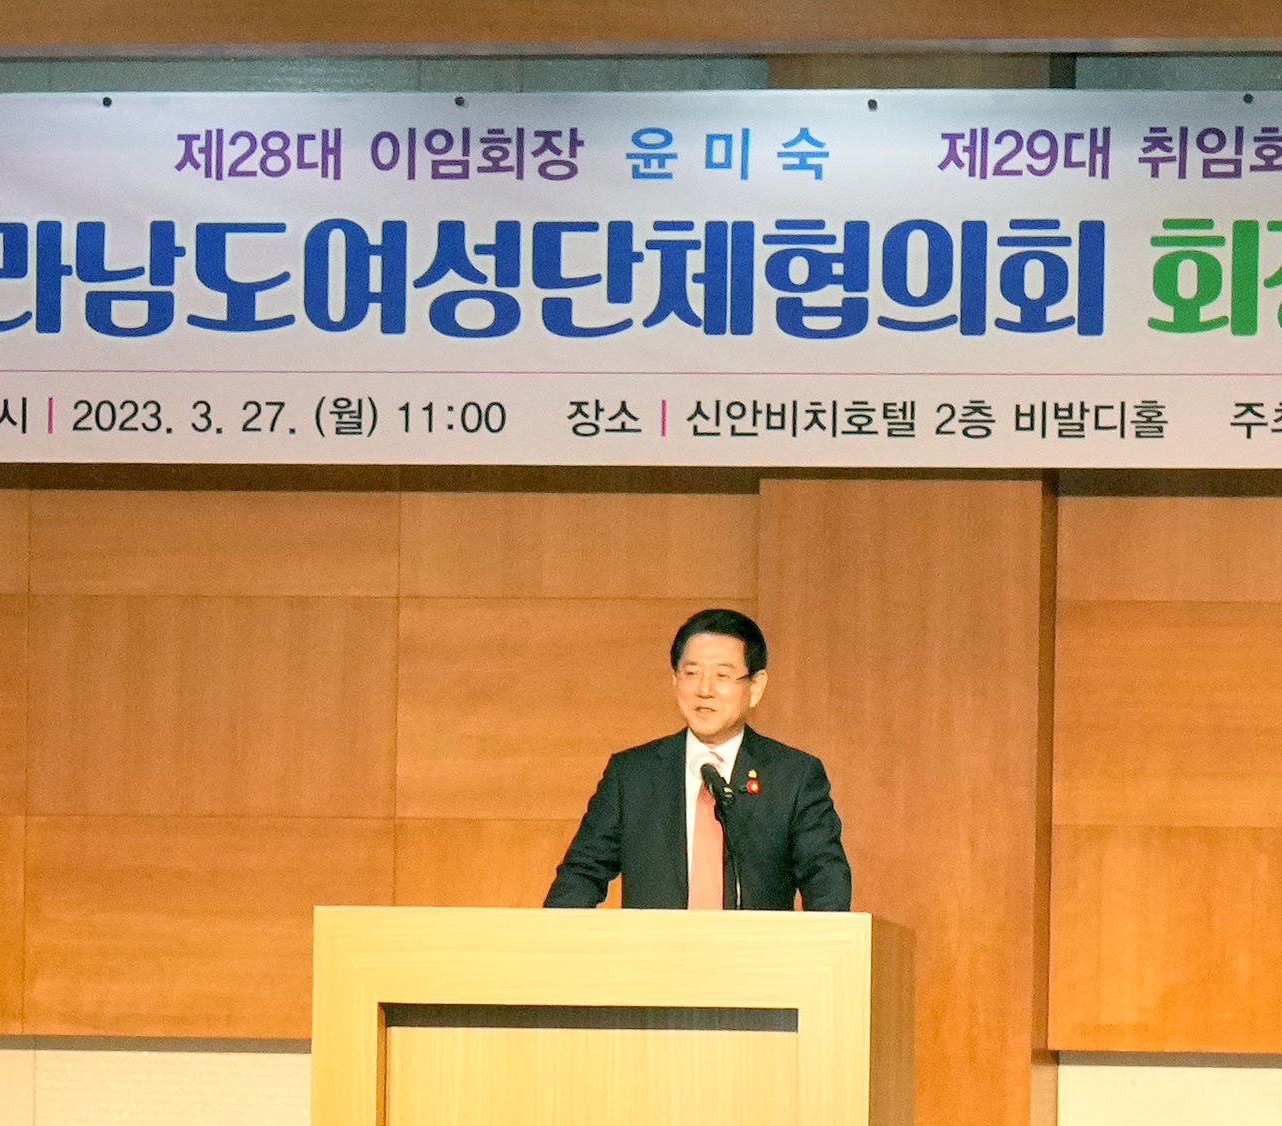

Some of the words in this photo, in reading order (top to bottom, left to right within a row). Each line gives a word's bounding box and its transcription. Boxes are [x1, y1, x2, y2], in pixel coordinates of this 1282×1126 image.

[175, 128, 341, 181] 제28대
[371, 125, 584, 181] 이임회장
[938, 126, 1111, 180] 제29대
[315, 396, 377, 437] (월)
[399, 401, 506, 433] 11:00
[567, 399, 642, 437] 장소
[687, 400, 915, 438] 신안비치호텔
[935, 400, 996, 439] 2층
[1015, 400, 1168, 438] 비발디홀
